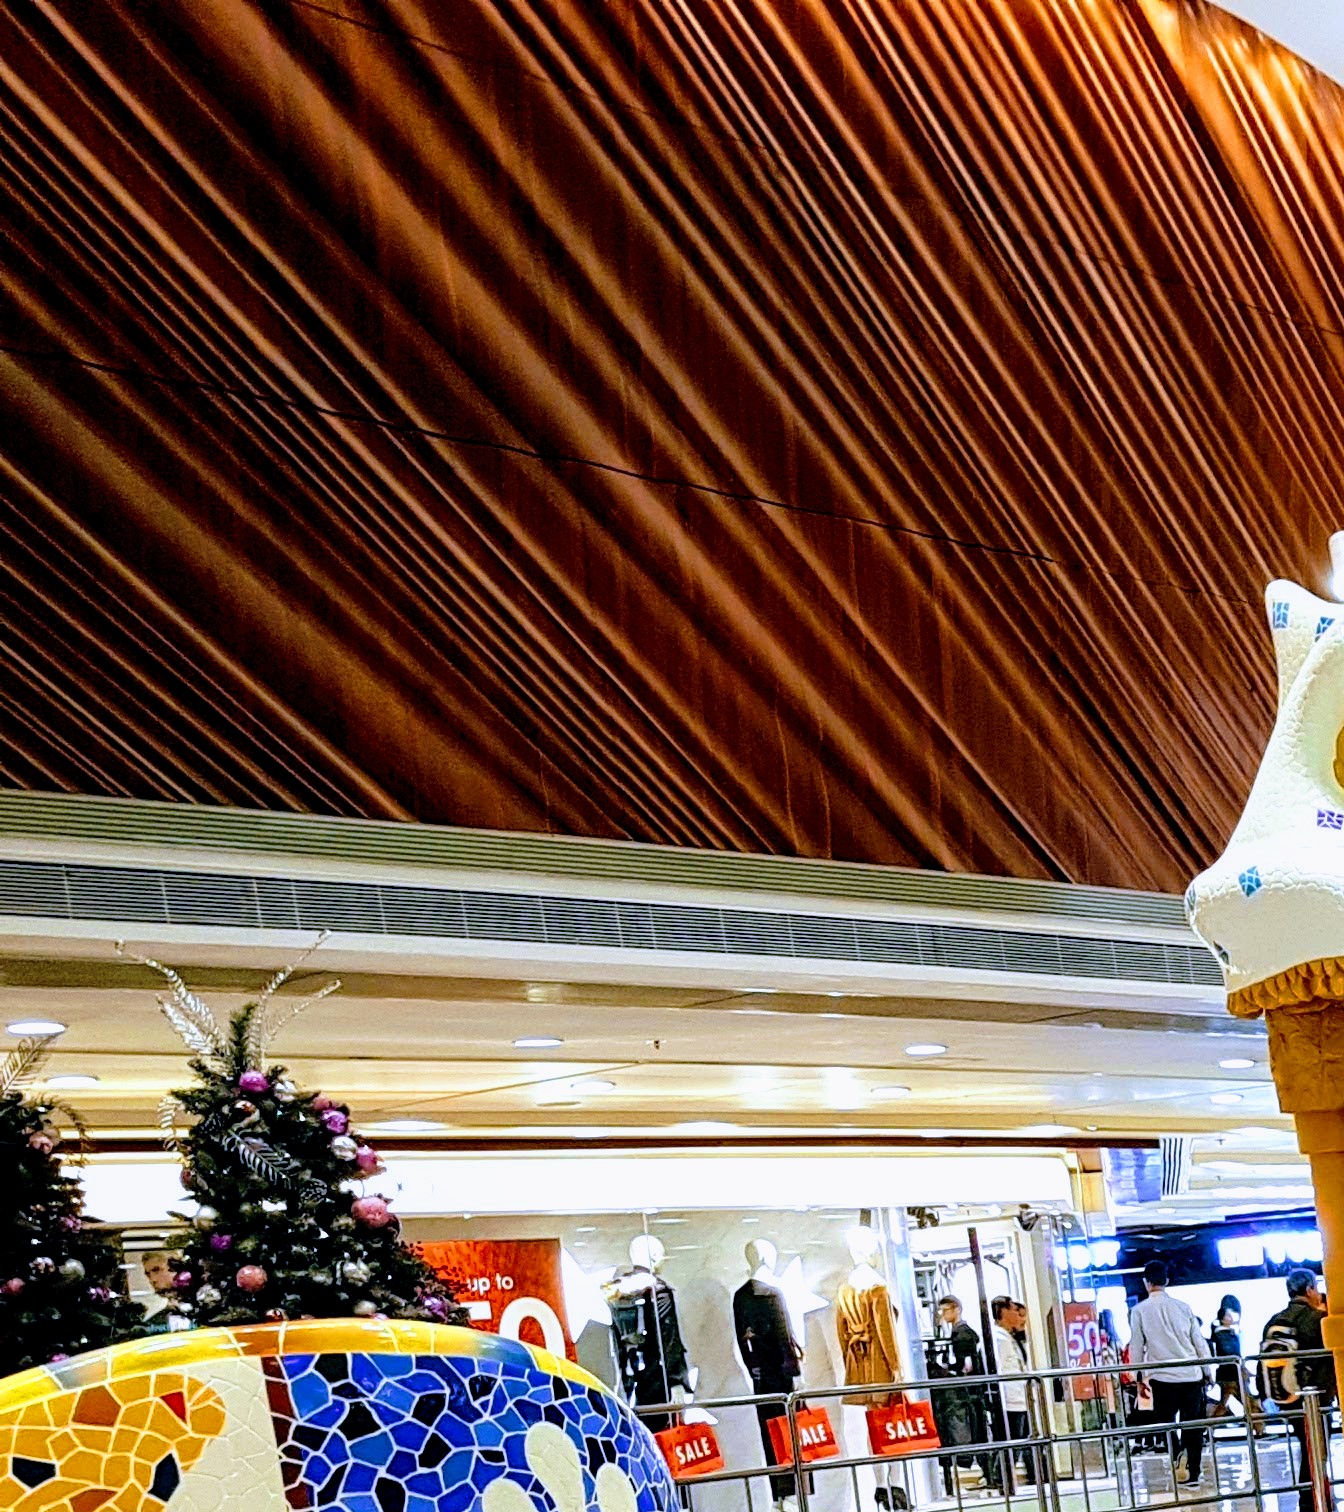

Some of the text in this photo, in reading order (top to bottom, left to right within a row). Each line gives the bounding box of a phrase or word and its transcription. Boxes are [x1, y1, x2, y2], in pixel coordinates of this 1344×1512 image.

[467, 1273, 514, 1296] up to
[1068, 1321, 1101, 1356] 50
[886, 1417, 927, 1439] SALE
[675, 1437, 711, 1464] SALE
